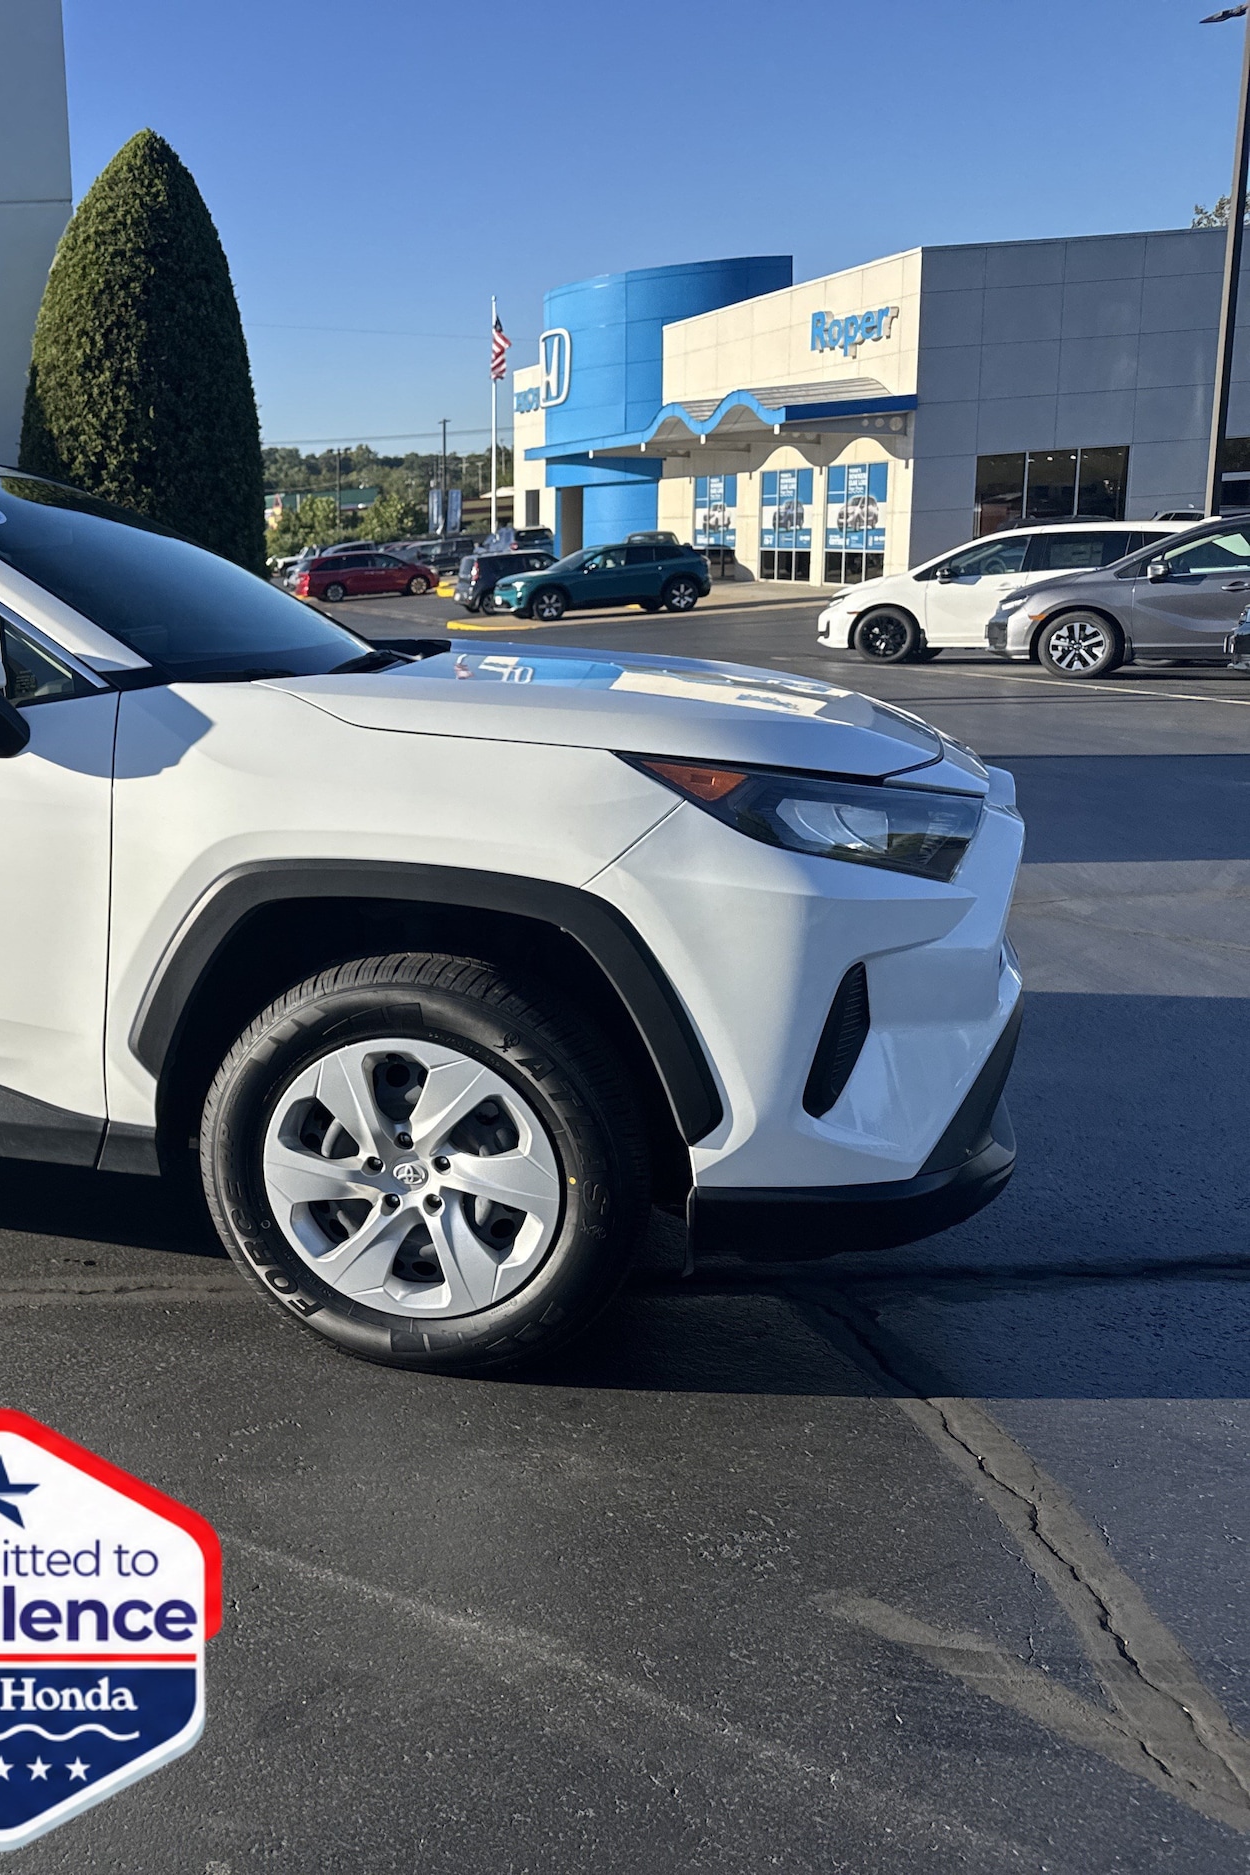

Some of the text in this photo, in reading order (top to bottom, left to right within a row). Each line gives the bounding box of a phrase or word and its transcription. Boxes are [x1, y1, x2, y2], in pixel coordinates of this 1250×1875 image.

[810, 306, 896, 358] Roper
[515, 1057, 611, 1216] ATLAS
[223, 1174, 326, 1318] FORCE
